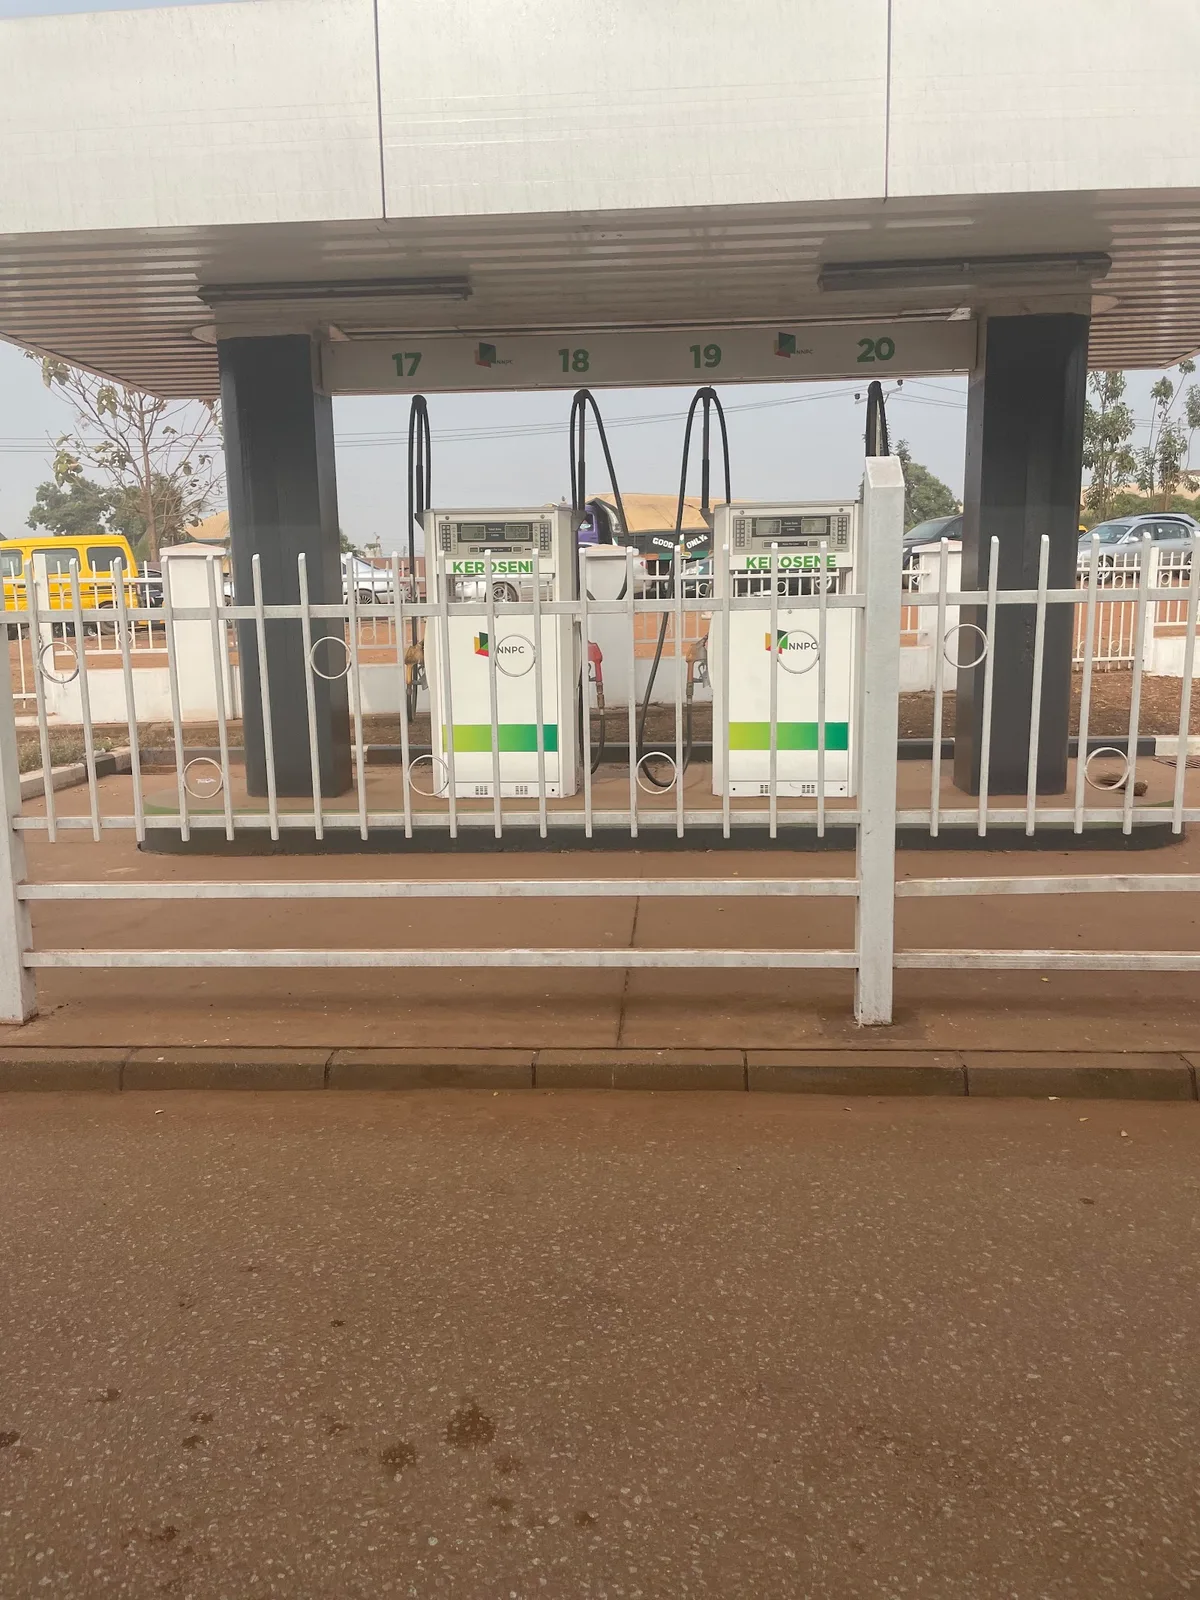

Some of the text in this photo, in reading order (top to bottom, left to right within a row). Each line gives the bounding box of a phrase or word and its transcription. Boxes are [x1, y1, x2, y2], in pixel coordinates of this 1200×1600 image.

[558, 348, 590, 373] 18
[689, 343, 722, 369] 19
[856, 336, 896, 363] 20
[391, 352, 422, 377] 17
[452, 561, 534, 574] KEROSEN
[746, 555, 836, 569] KEOSENE
[497, 645, 525, 654] NNPC
